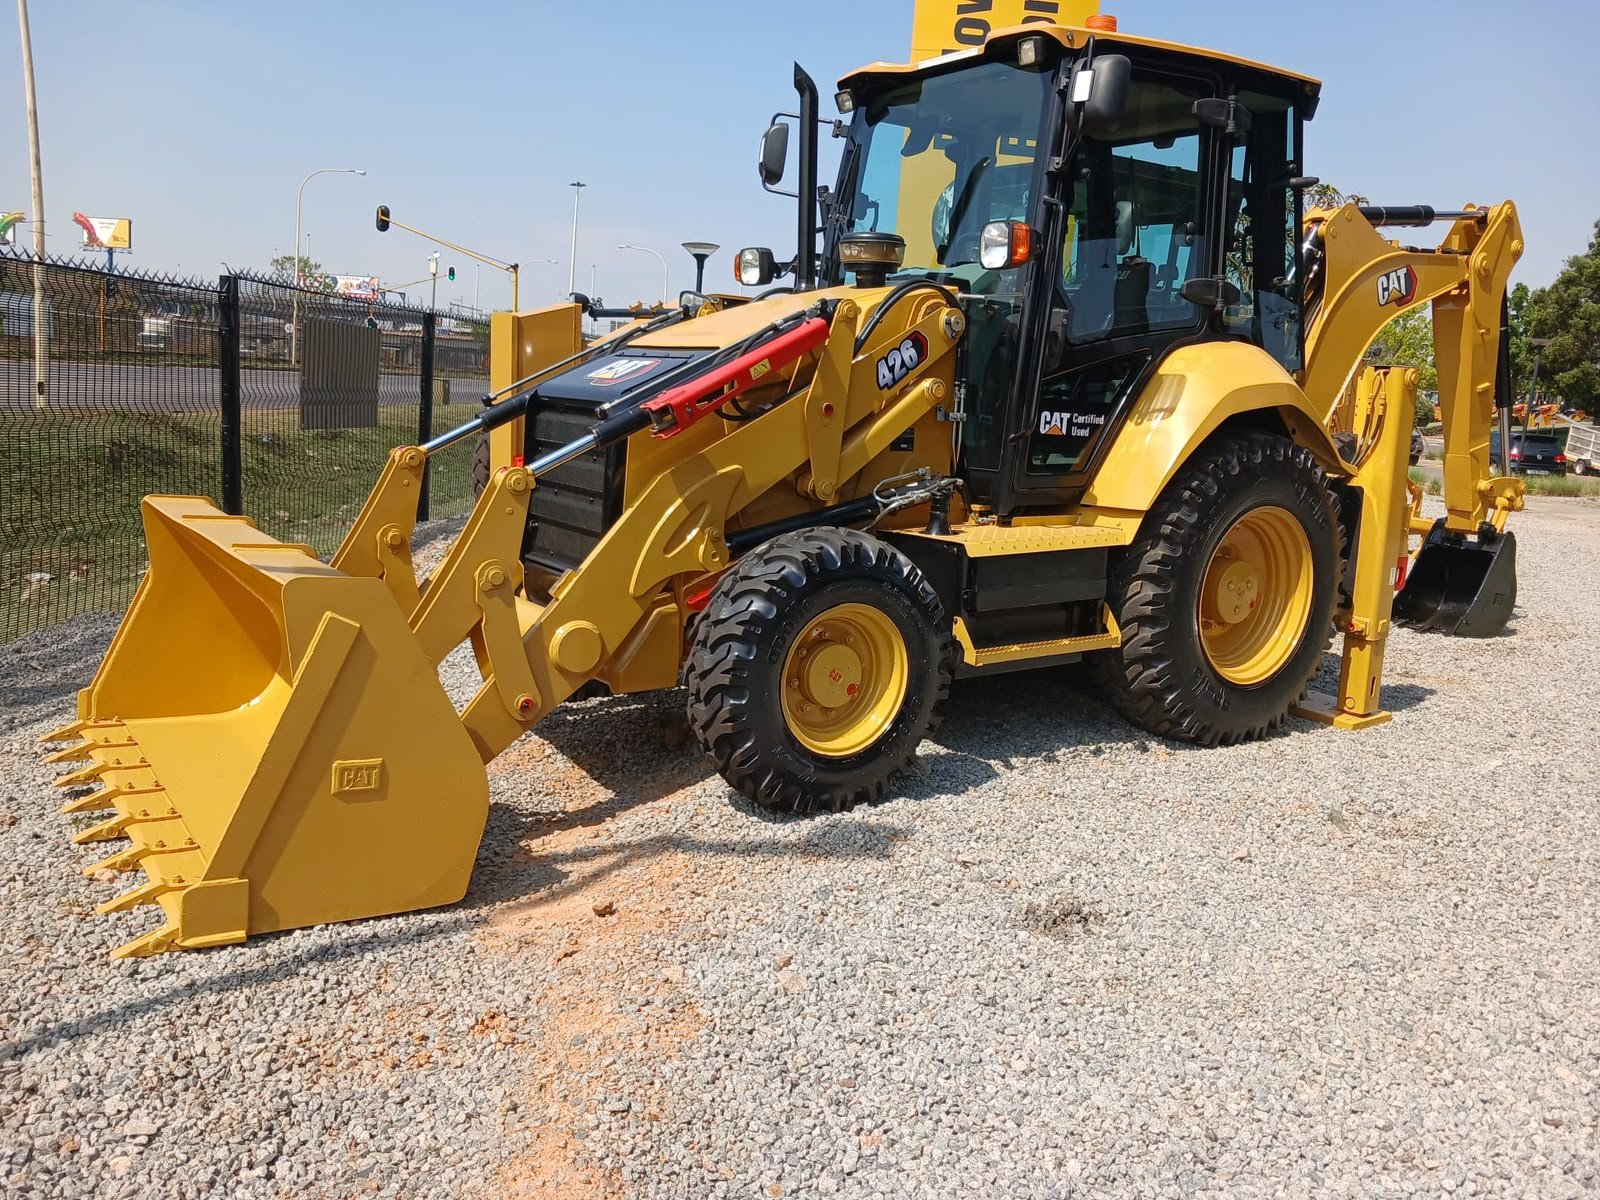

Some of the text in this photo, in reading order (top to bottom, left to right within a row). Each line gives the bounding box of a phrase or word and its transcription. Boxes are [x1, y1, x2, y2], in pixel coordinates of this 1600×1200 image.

[1377, 266, 1407, 306] CAT
[586, 359, 657, 379] CAT
[877, 339, 919, 388] 426
[1040, 411, 1105, 435] CAT Certified
[1071, 426, 1090, 437] Used
[341, 767, 379, 791] CAT
